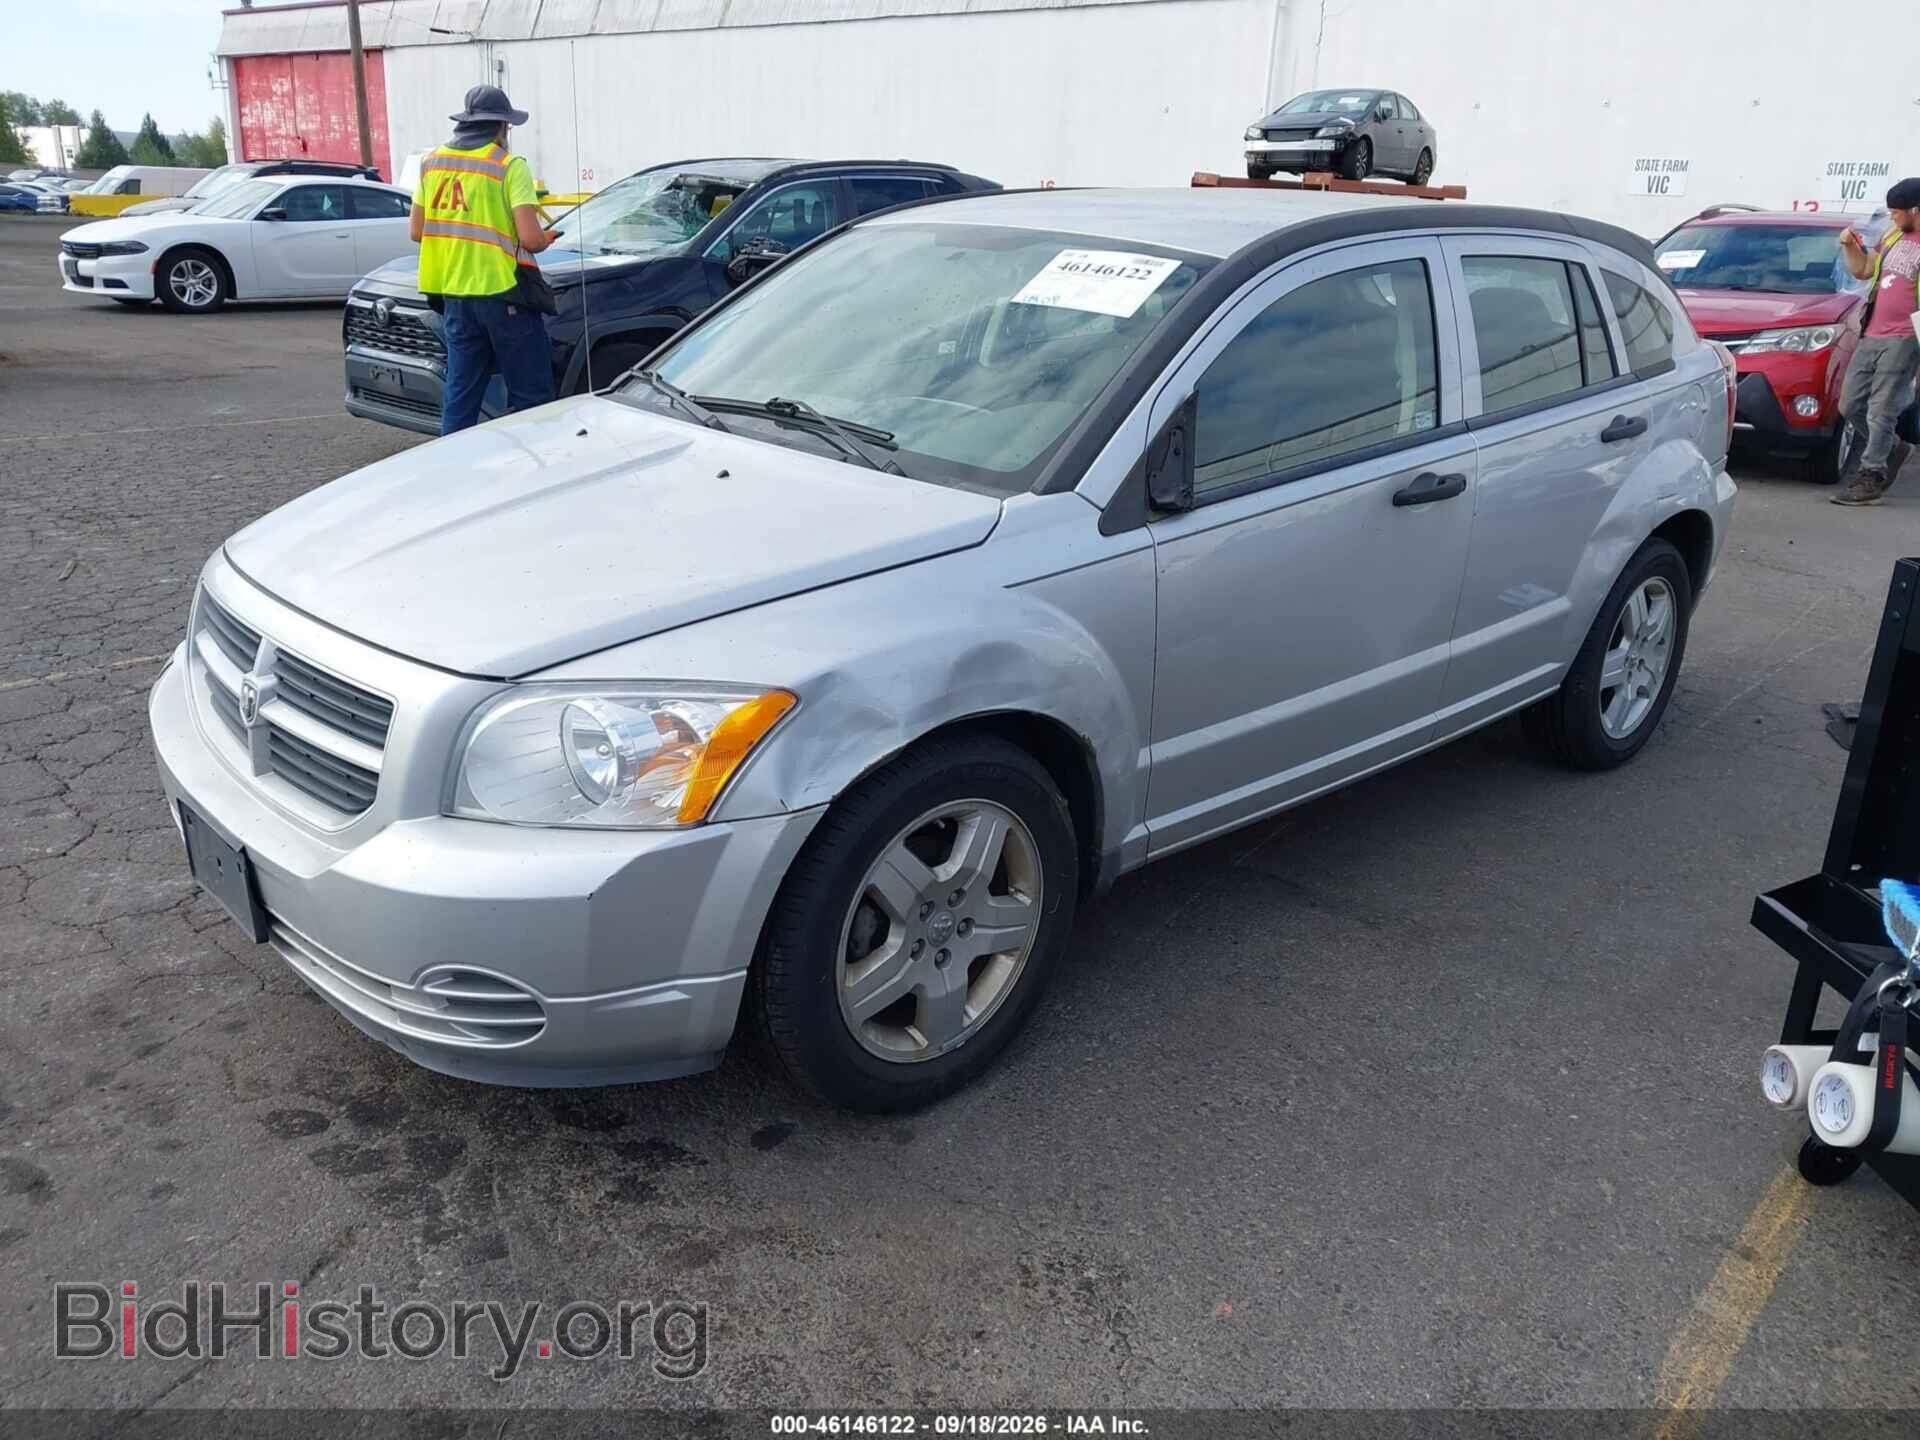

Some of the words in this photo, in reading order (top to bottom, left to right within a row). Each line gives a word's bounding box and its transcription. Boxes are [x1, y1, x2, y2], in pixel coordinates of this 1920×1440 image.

[1634, 159, 1661, 172] STATE
[1662, 159, 1689, 172] FARM
[1826, 162, 1856, 176] STATE
[1857, 162, 1890, 176] FARM
[581, 168, 593, 180] 20
[1647, 175, 1670, 194] VIC
[1840, 180, 1867, 200] VIC
[1057, 261, 1152, 281] 46146122
